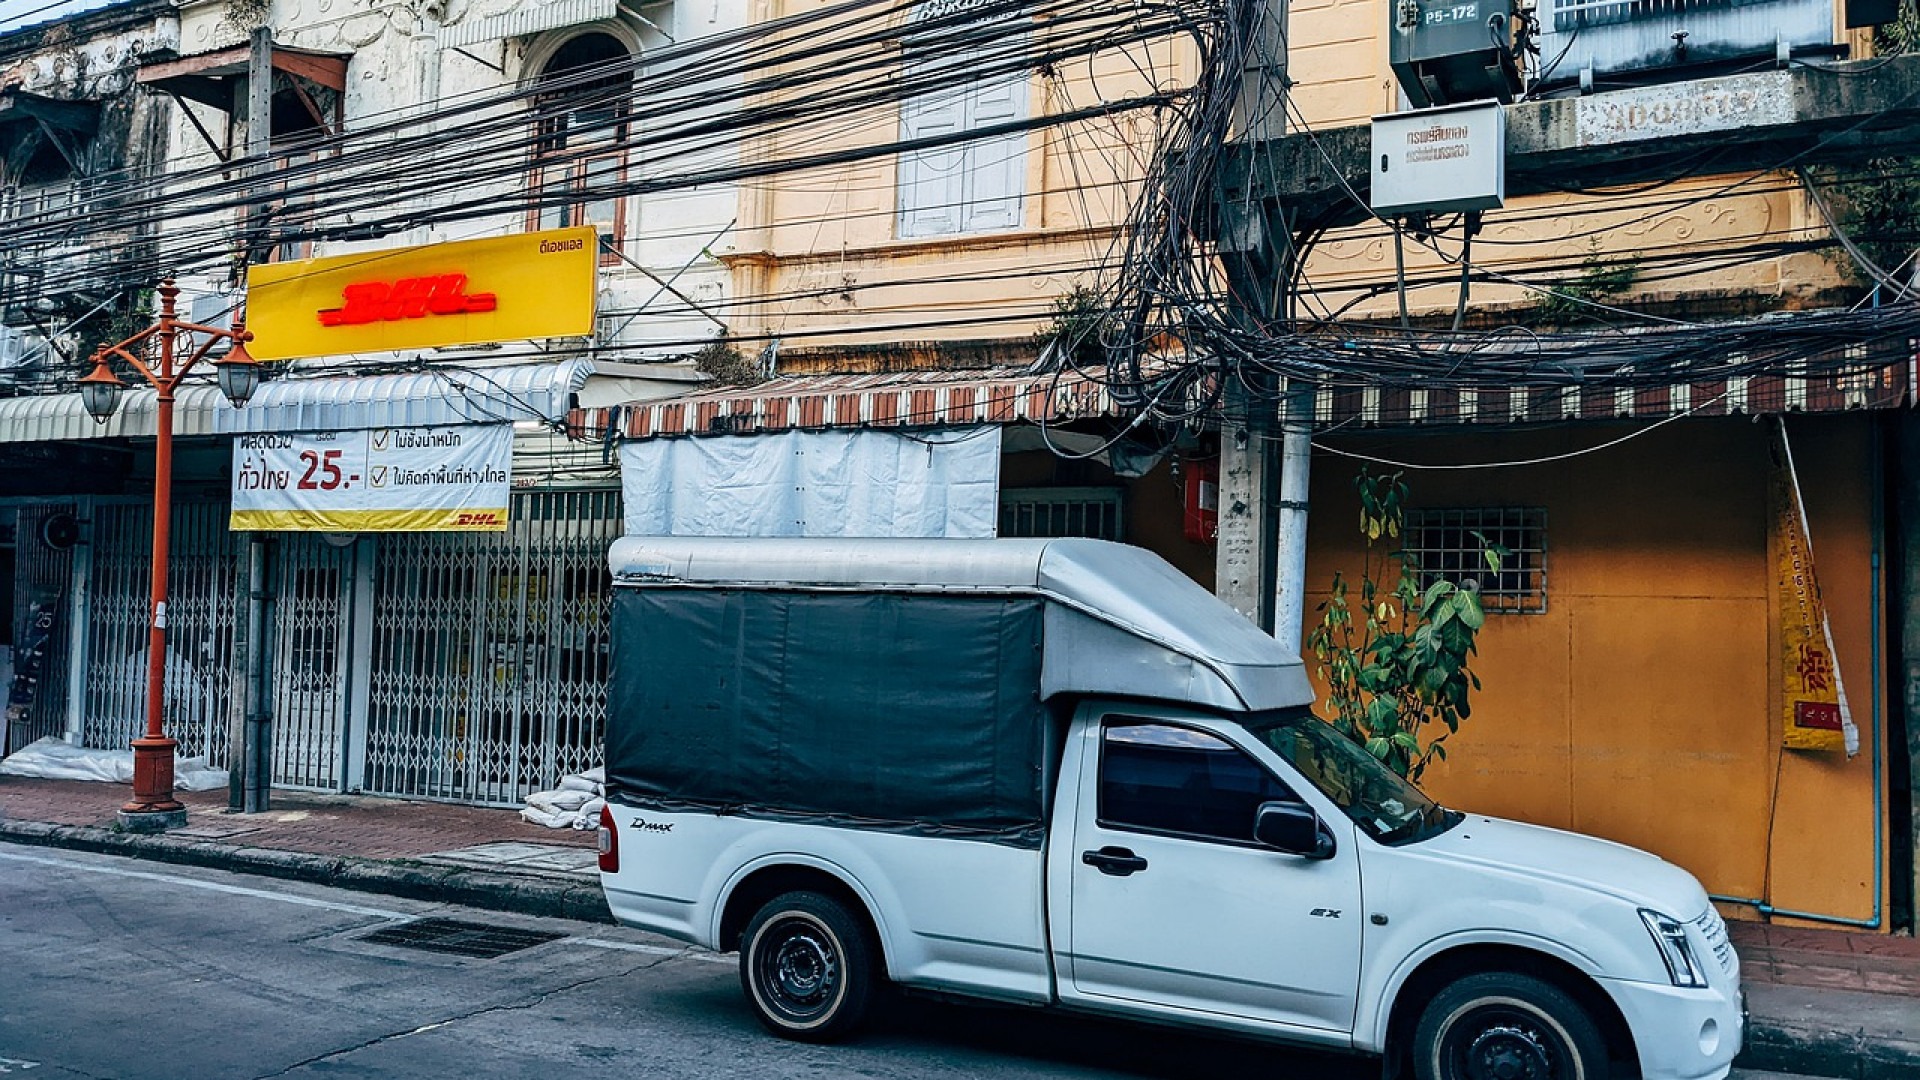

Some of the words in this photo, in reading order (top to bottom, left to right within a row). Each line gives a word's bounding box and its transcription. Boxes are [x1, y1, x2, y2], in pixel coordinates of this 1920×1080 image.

[1425, 5, 1476, 24] P5-172
[539, 239, 583, 254] ดีเอชแอล
[338, 273, 472, 326] DHL
[238, 456, 290, 490] ทั่วไทย
[455, 513, 500, 526] DHL
[1309, 908, 1342, 919] EX
